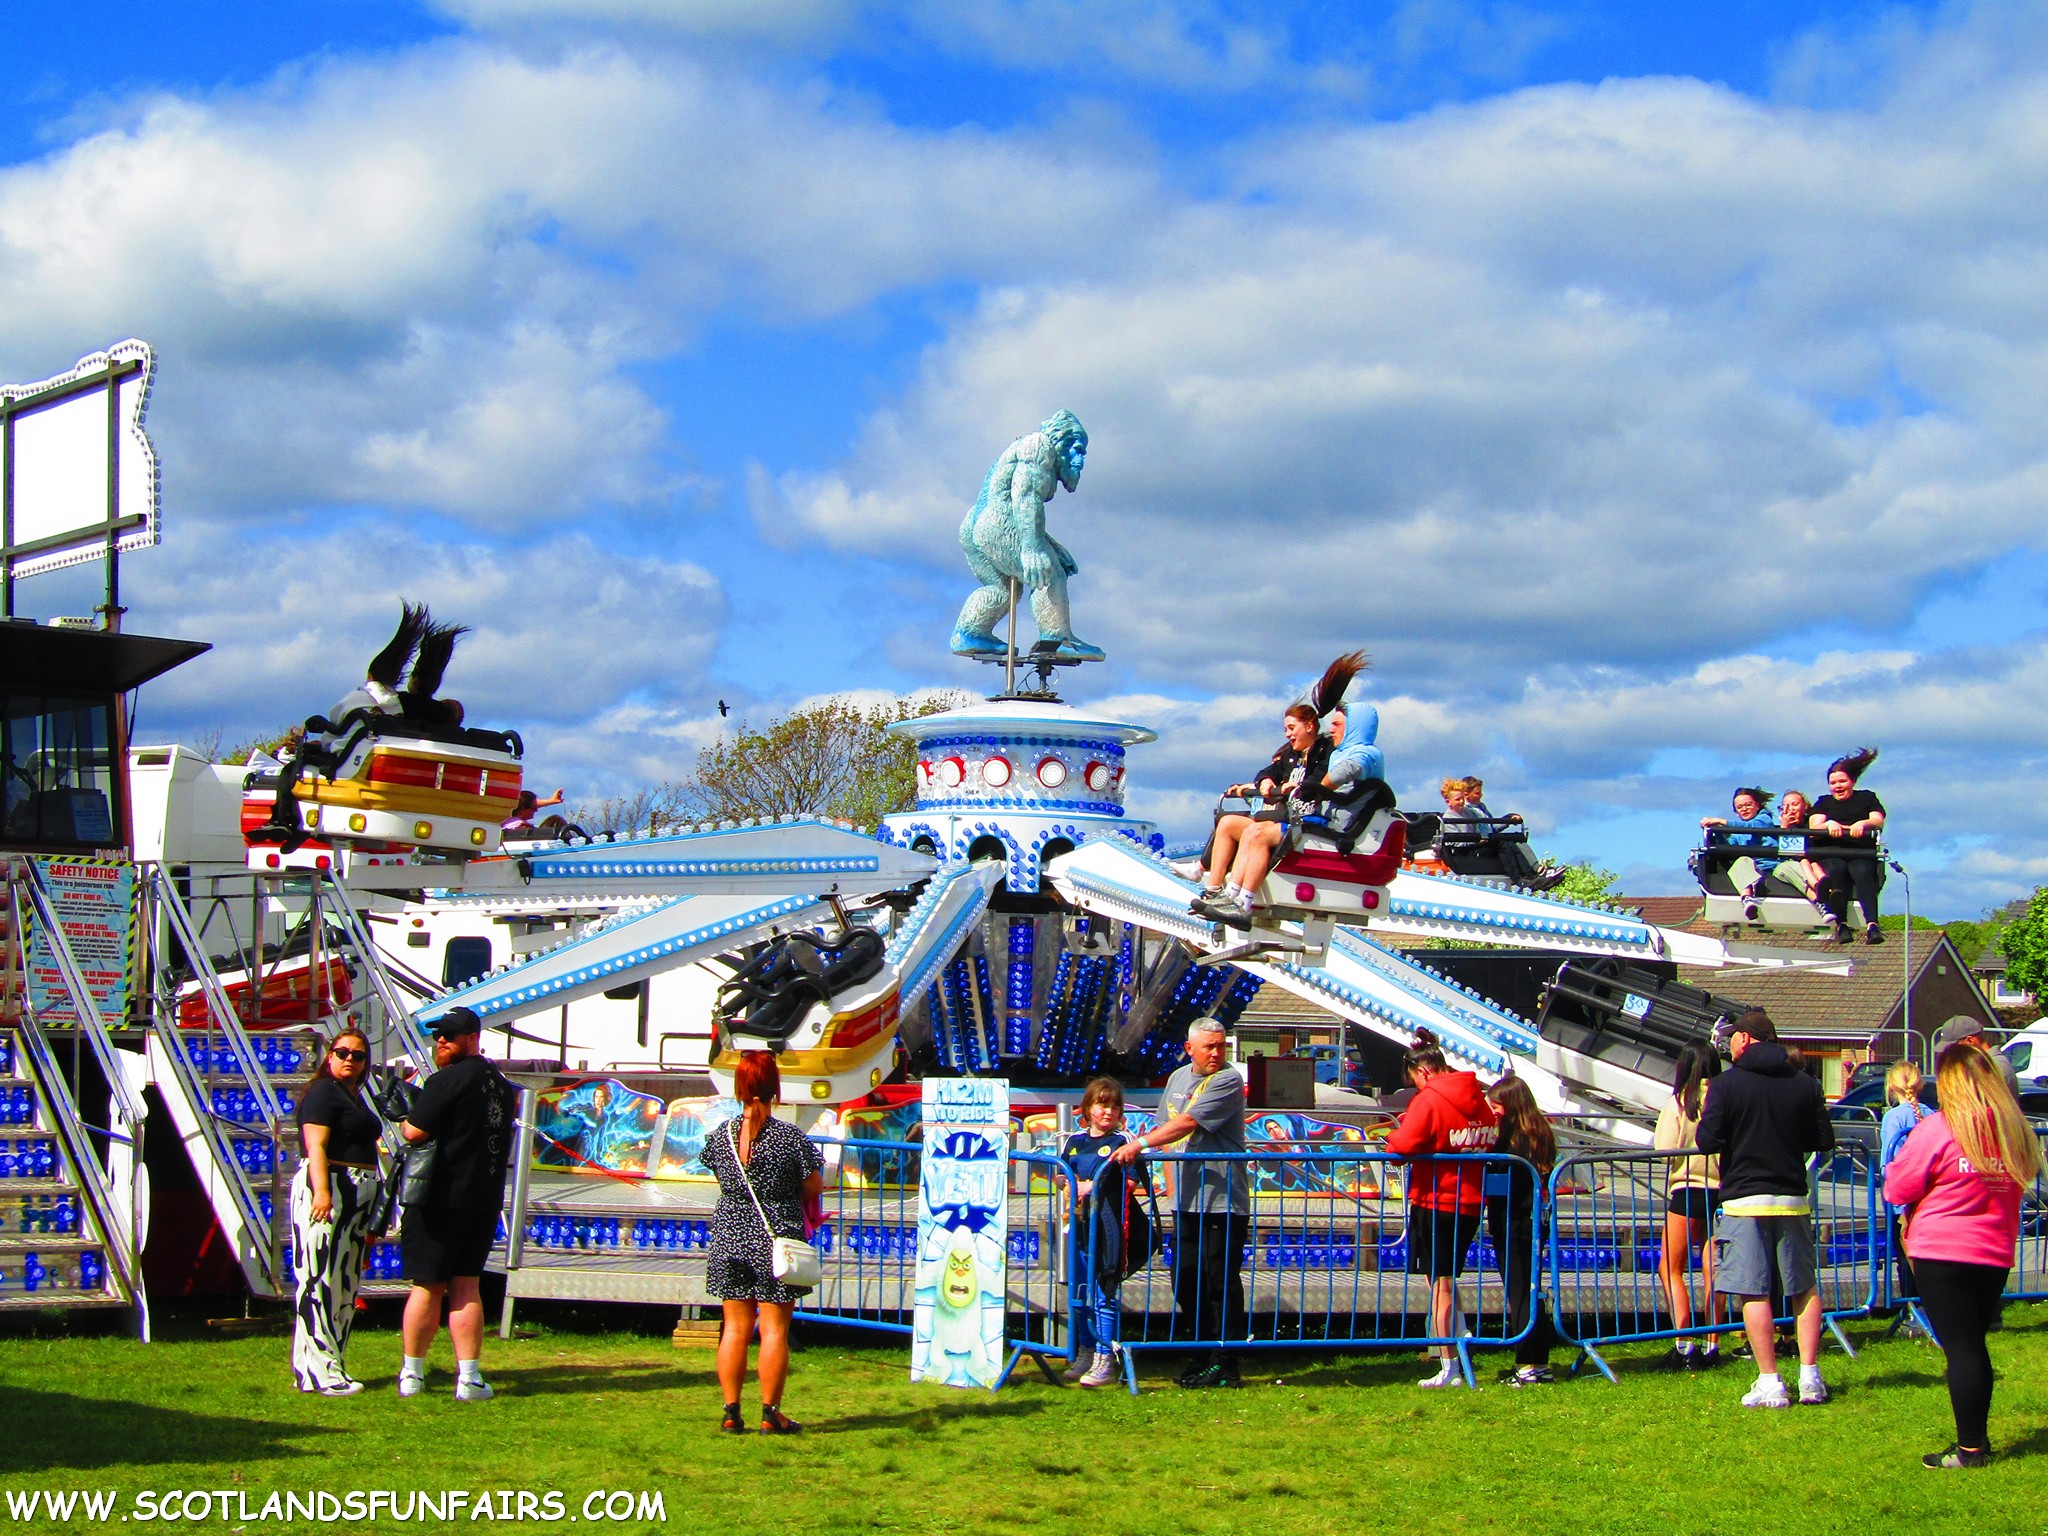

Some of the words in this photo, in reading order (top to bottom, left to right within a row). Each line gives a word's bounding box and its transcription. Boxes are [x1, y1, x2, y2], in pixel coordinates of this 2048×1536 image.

[49, 865, 83, 876] SAFETY
[86, 867, 119, 879] NOTICE
[812, 1022, 822, 1034] 6
[938, 1080, 993, 1105] 1.2M
[938, 1106, 958, 1121] TO
[960, 1106, 994, 1122] RIDE
[924, 1160, 1005, 1206] YETI
